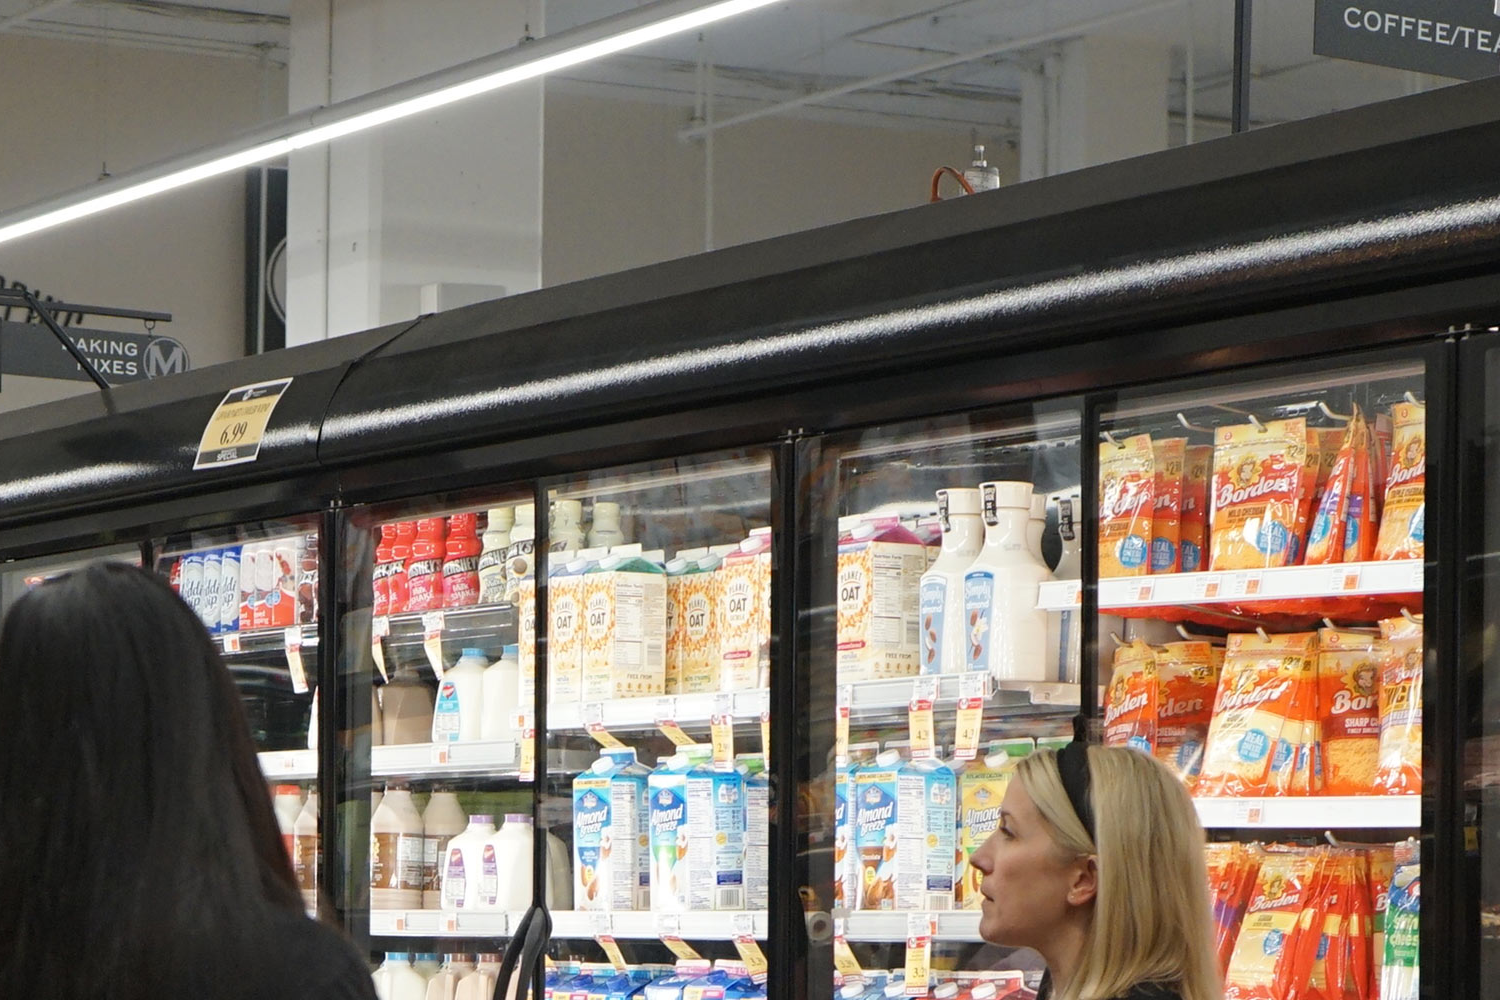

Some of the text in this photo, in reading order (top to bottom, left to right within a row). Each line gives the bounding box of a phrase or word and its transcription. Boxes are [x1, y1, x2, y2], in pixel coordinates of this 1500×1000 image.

[220, 421, 248, 445] 6.99
[1217, 476, 1291, 508] Borden
[841, 586, 861, 601] OAT
[729, 597, 748, 612] OAT
[557, 615, 572, 629] OAT
[589, 613, 606, 627] OAT
[689, 613, 705, 628] OAT
[1104, 693, 1148, 727] Borden
[1344, 717, 1369, 728] SHARP
[576, 805, 608, 828] Almond
[651, 805, 683, 827] Almond
[857, 802, 892, 827] Almond
[580, 823, 602, 839] Breeze
[861, 818, 887, 838] Breeze
[970, 816, 998, 838] Breeze
[1250, 892, 1299, 912] Borden
